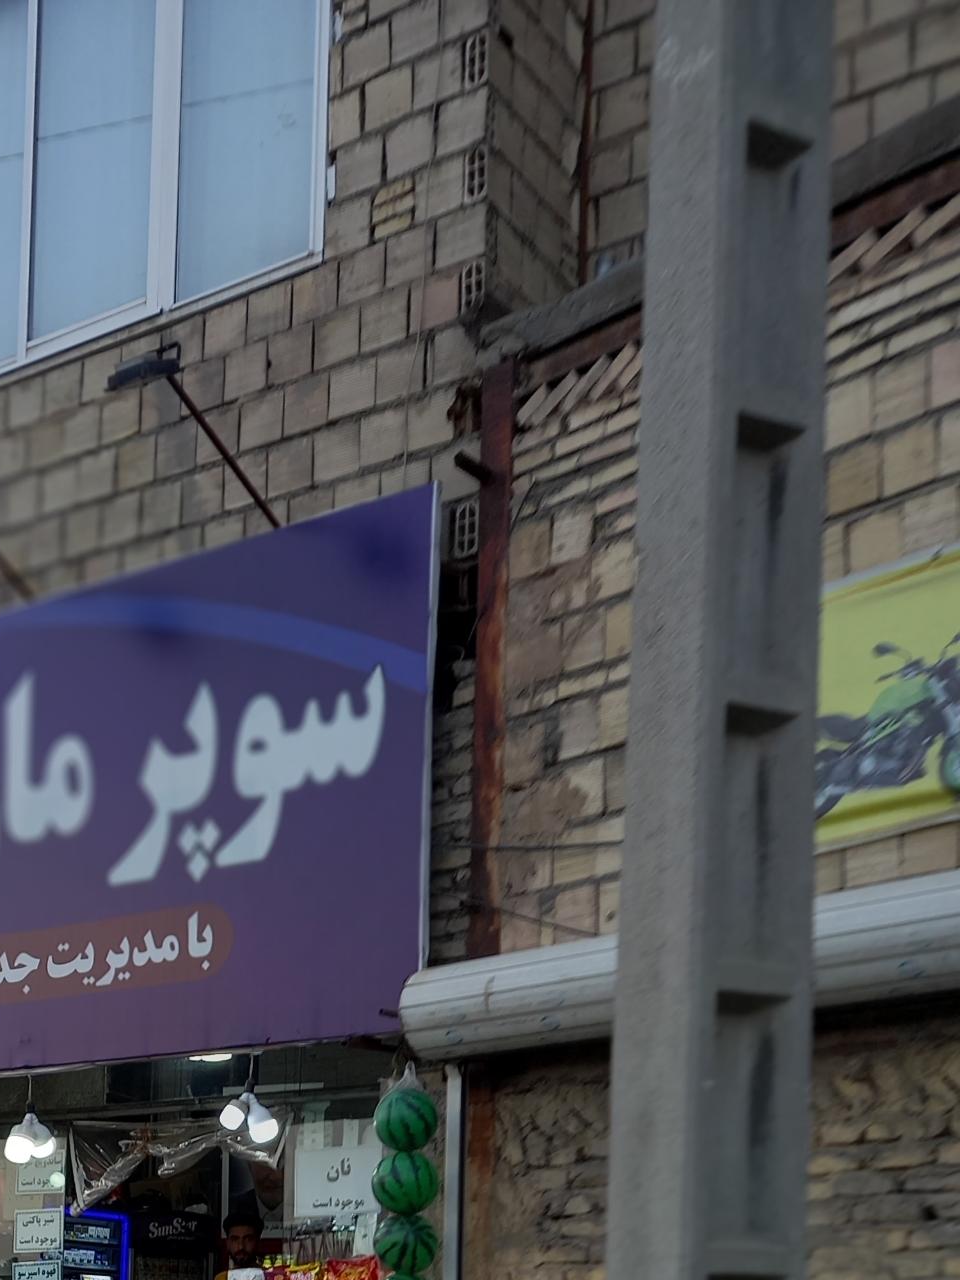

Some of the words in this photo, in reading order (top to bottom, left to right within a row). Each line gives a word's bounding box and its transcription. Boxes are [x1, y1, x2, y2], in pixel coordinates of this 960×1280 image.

[107, 663, 386, 886] سوپر
[187, 910, 213, 970] با
[46, 929, 180, 986] مدیریت
[327, 1156, 352, 1183] نان
[20, 1176, 36, 1186] است
[312, 1196, 333, 1209] است
[334, 1197, 365, 1210] موجود
[34, 1236, 58, 1246] موجود
[42, 1265, 56, 1278] قهوه
